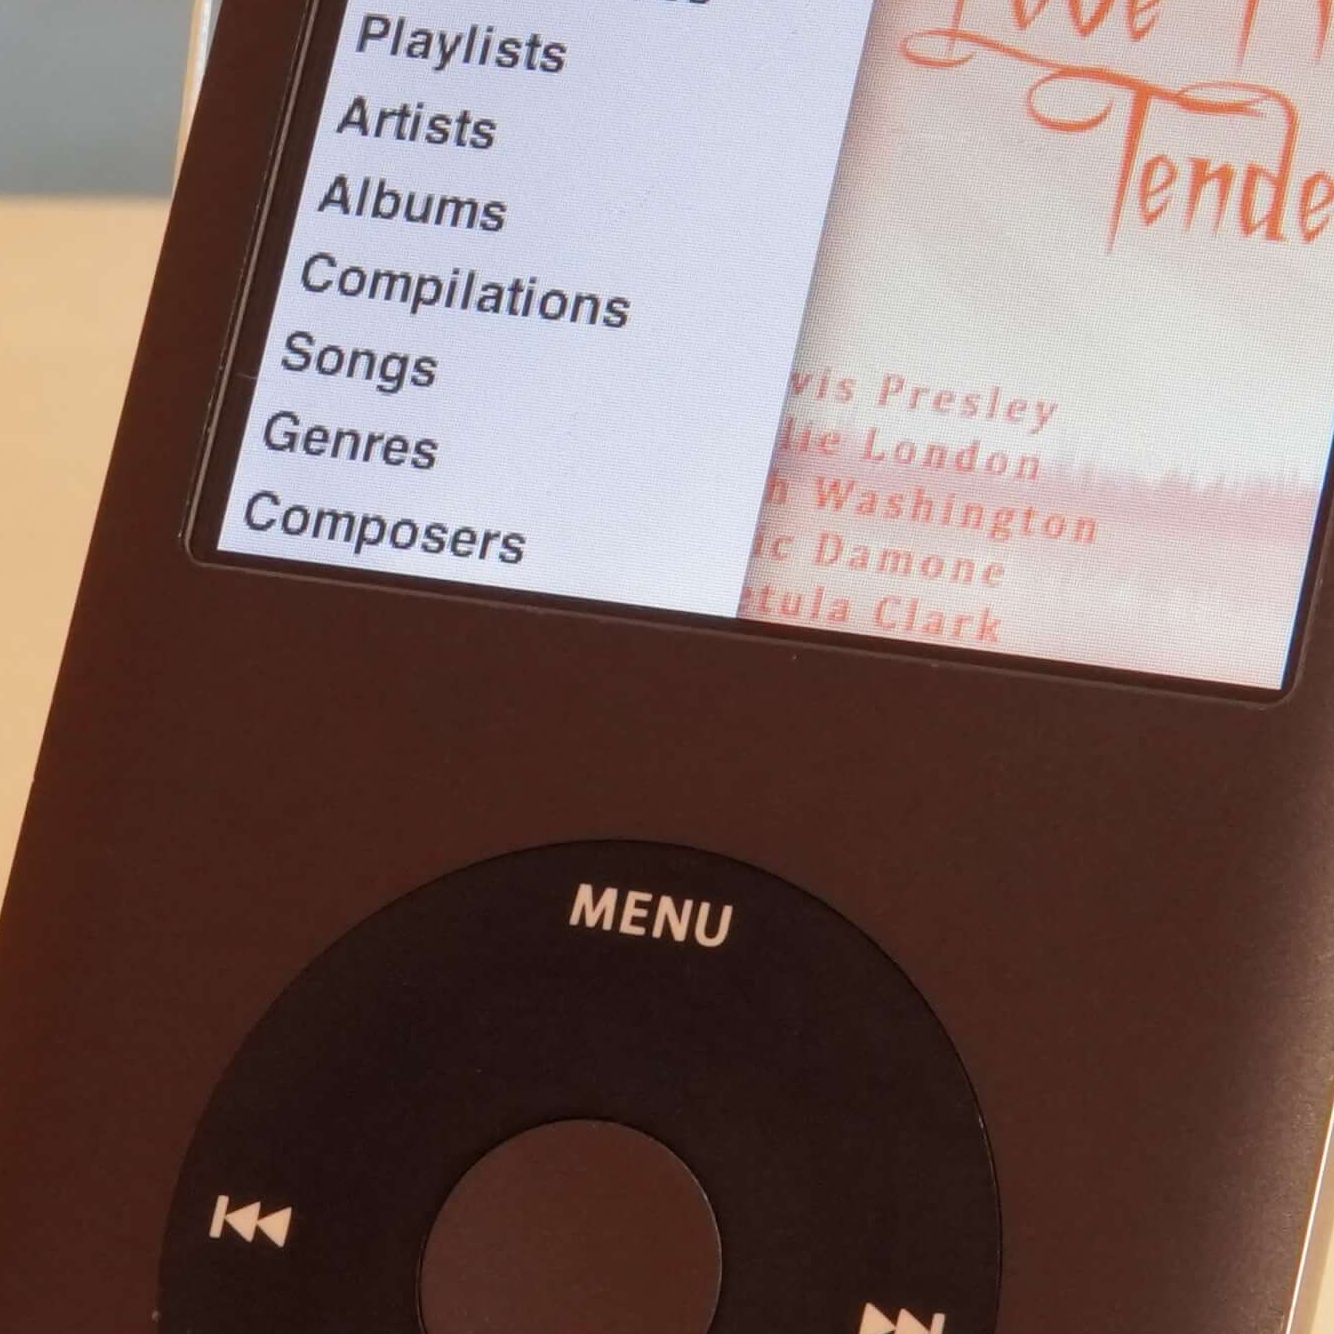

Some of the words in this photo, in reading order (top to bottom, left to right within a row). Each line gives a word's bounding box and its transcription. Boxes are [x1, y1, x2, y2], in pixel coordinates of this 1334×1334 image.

[356, 15, 567, 74] Playlists
[337, 95, 497, 149] Artists
[318, 175, 508, 232] Albums
[300, 252, 631, 329] Compilations
[281, 331, 438, 394] Songs
[878, 374, 1060, 434] Presley
[263, 411, 438, 470] Genres
[863, 427, 1042, 481] London
[243, 491, 527, 565] Composers
[815, 478, 1100, 543] Washington
[815, 536, 1007, 587] Damone
[875, 594, 1003, 643] Clark
[569, 883, 733, 947] MENU
